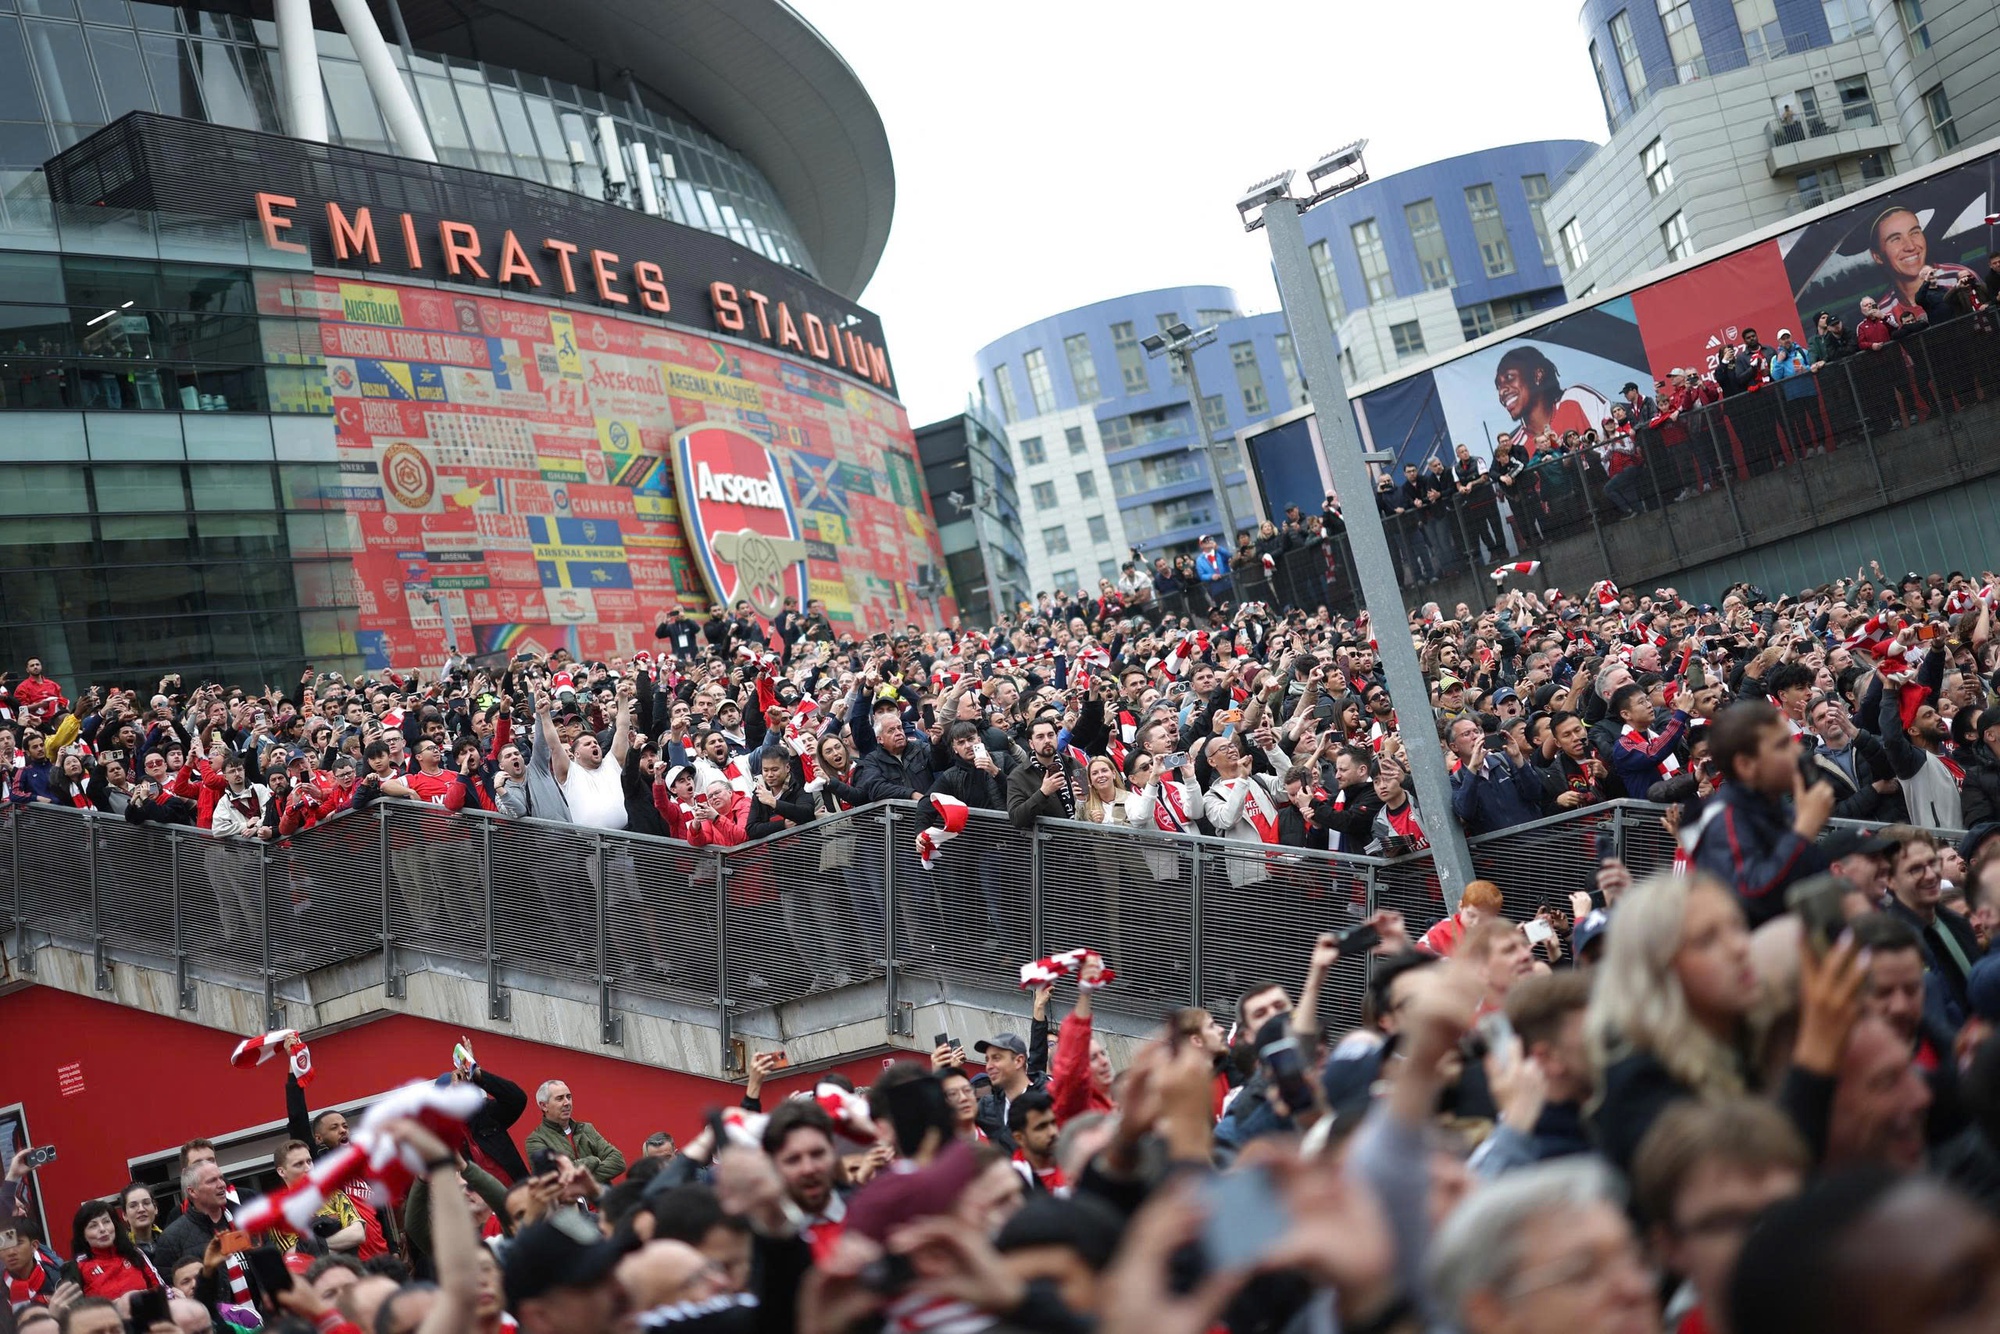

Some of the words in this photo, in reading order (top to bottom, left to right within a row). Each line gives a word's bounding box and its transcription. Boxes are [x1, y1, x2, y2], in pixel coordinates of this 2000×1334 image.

[255, 192, 671, 313] EMIRATES
[709, 281, 892, 388] STADIUM
[344, 298, 403, 326] AUSTRALIA
[338, 328, 394, 357] ARSENAL
[391, 332, 429, 360] FAROE
[427, 336, 475, 364] ISLANDS
[669, 371, 713, 396] ARSENAL
[363, 416, 406, 435] ARSENAL
[546, 471, 581, 481] GHANA
[697, 461, 784, 510] Arsenal
[572, 498, 636, 516] GUNNERS
[440, 552, 471, 561] ARSENAL
[538, 548, 582, 558] ARSENAL
[585, 549, 624, 558] SWEDEN
[437, 579, 461, 588] SOUTH
[462, 579, 485, 587] SUDAN
